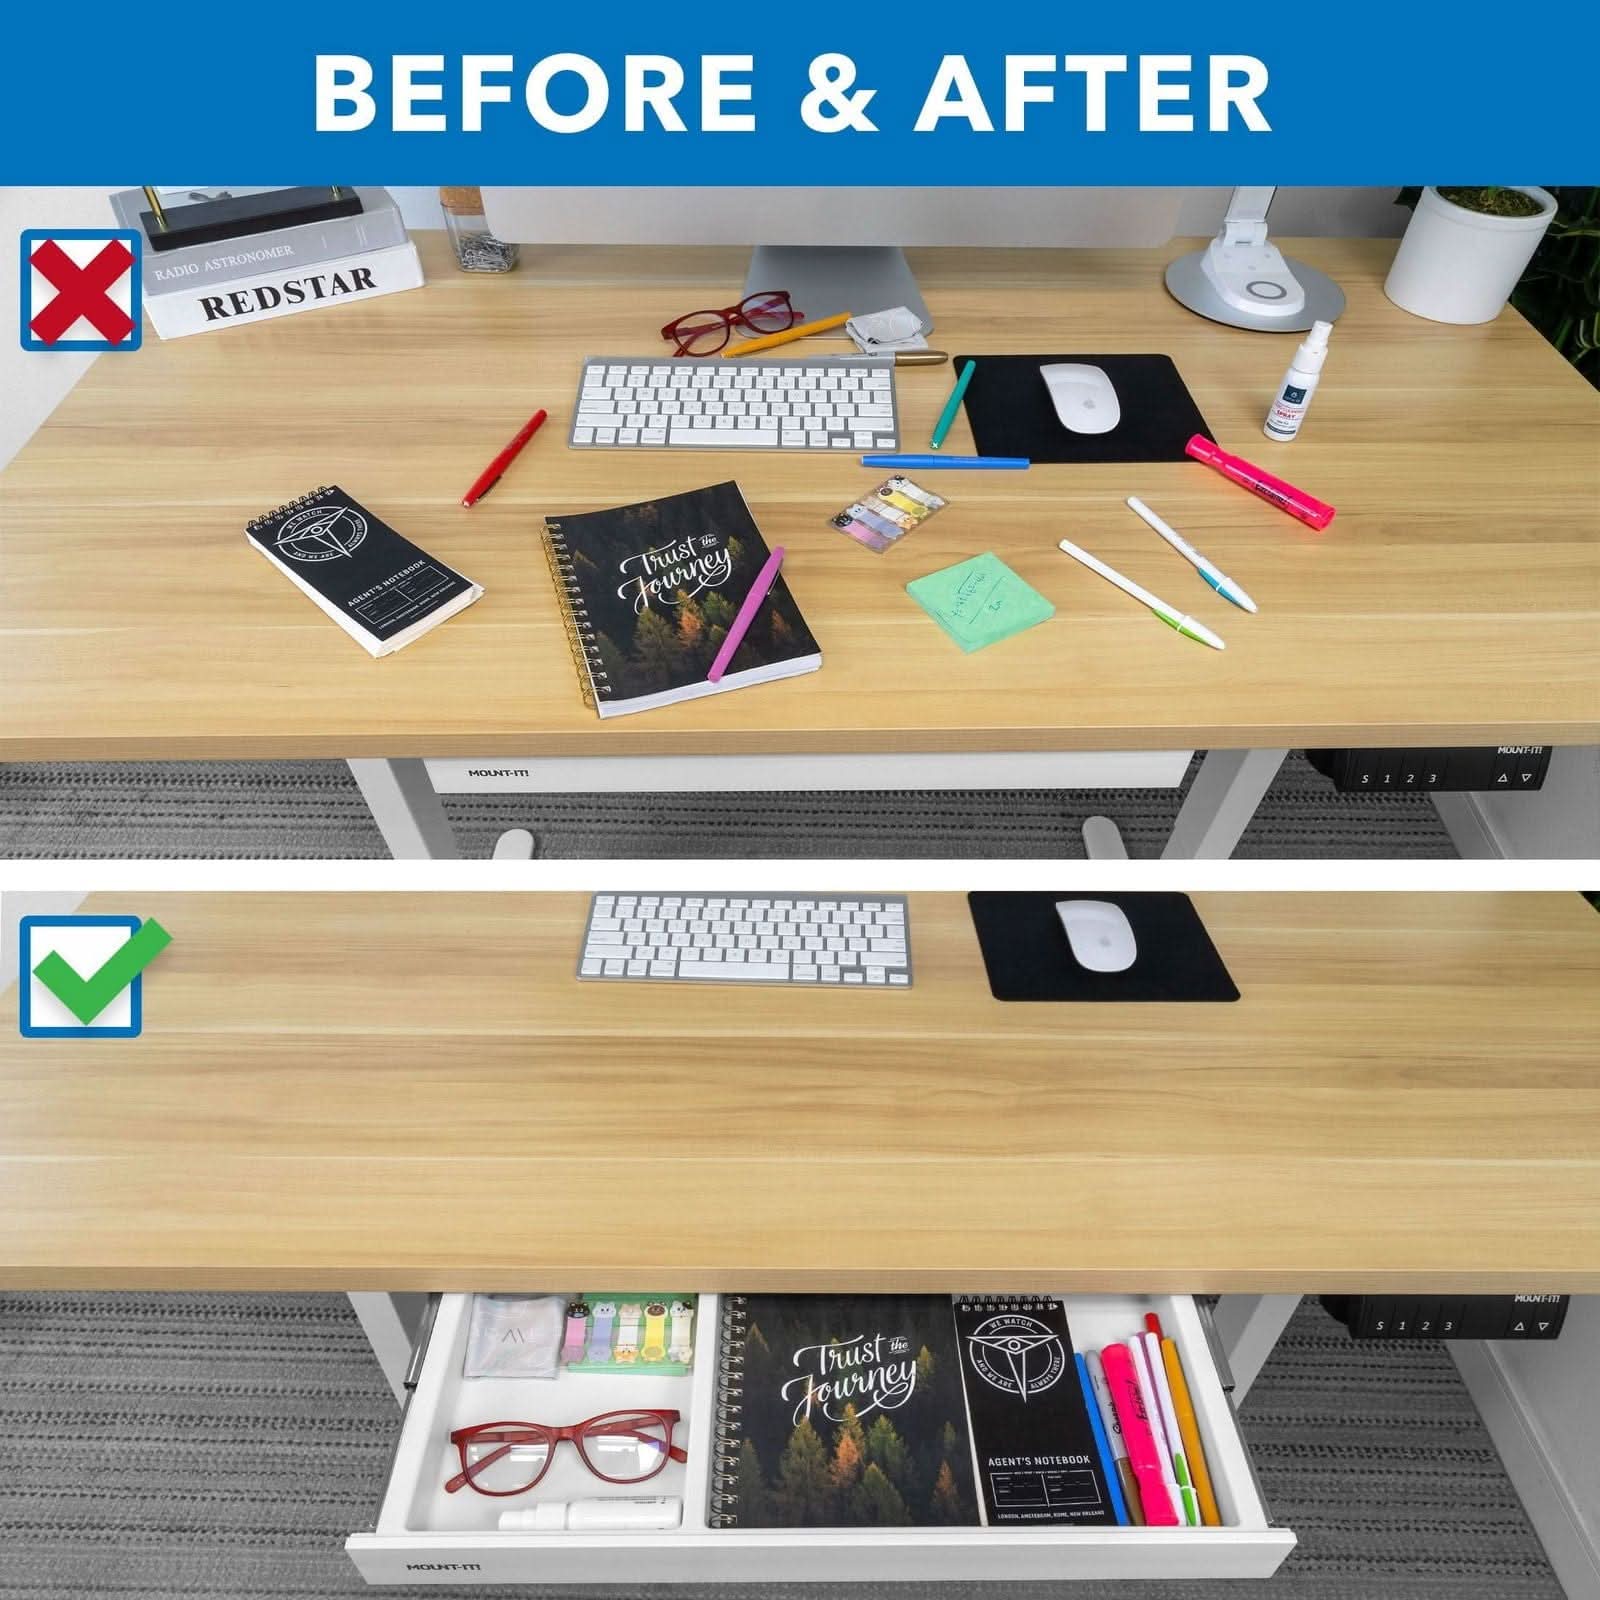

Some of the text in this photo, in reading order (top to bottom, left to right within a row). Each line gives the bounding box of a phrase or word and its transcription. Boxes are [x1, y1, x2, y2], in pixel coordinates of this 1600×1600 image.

[155, 245, 295, 281] RADIO ASTRONOMER
[198, 267, 378, 322] REDSTAR
[620, 534, 718, 575] Trust the
[347, 585, 383, 607] AGENT'S
[382, 559, 427, 587] NOTEBOOK
[617, 548, 732, 616] Journey
[1497, 746, 1543, 755] MOUNT-IT!
[468, 769, 529, 777] MOUNT-IT!
[1361, 774, 1437, 784] S 1 2 3
[988, 1318, 1033, 1329] WE WATCH
[1376, 1321, 1453, 1331] S 1 2 3
[792, 1333, 909, 1375] Trust the
[977, 1359, 1013, 1389] AND WE ARE
[1030, 1374, 1054, 1389] ALWAYS
[781, 1360, 917, 1428] Journey
[988, 1455, 1091, 1467] AGENT'S NOTEBOOK
[406, 1563, 481, 1571] MOUNT-IT!
